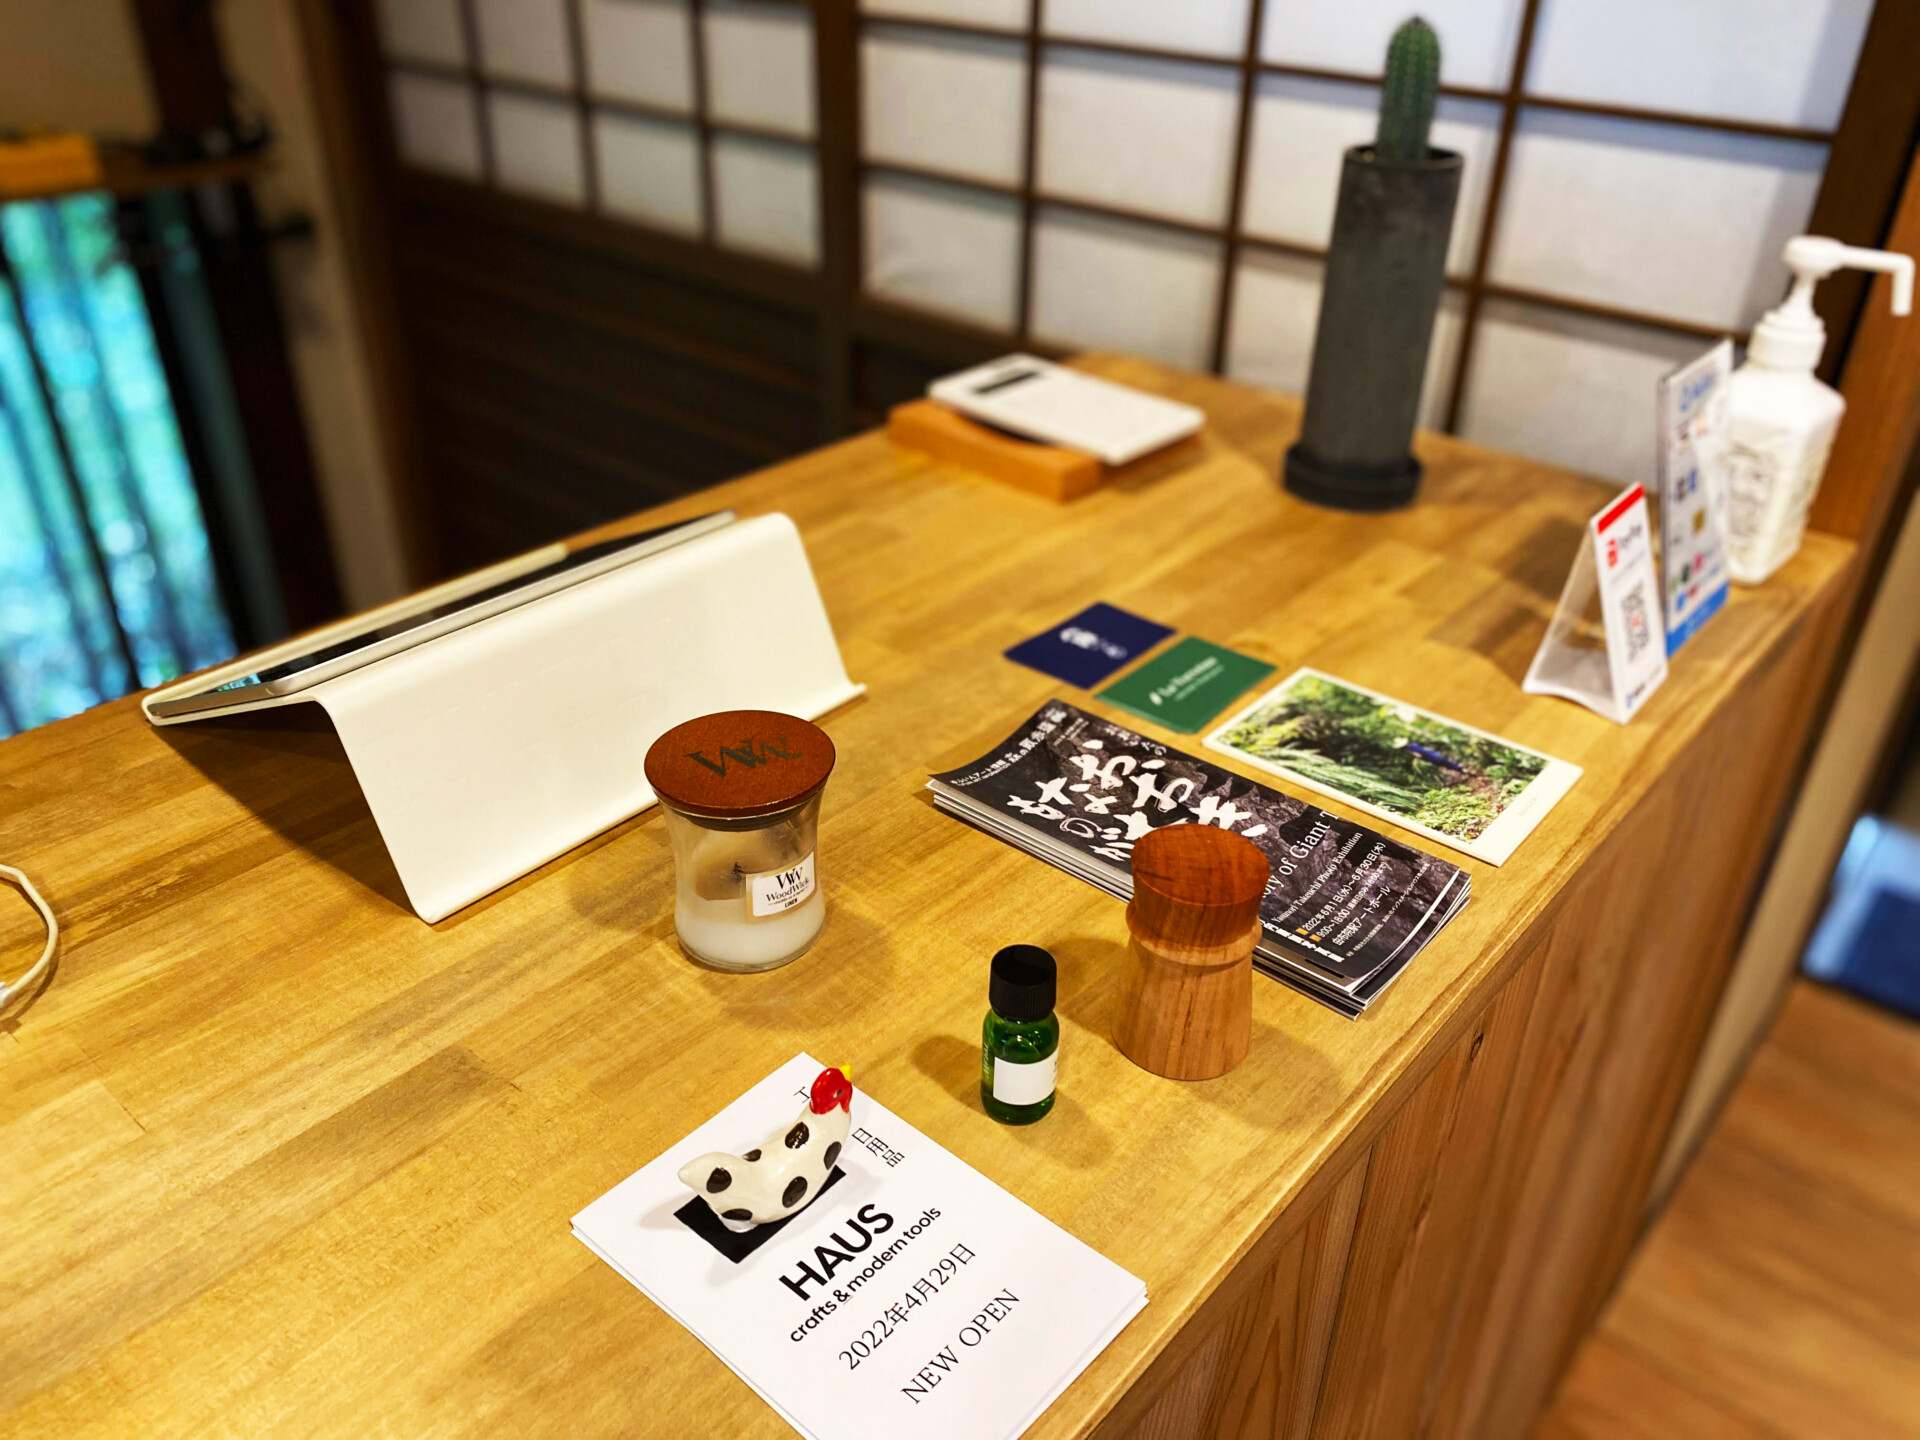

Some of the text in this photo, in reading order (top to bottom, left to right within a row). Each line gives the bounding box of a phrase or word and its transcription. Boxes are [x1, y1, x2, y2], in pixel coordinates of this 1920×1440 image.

[1278, 856, 1299, 877] of
[1288, 820, 1332, 860] Giant
[1296, 882, 1321, 911] Takeuchi
[1316, 864, 1338, 887] Photo
[1332, 832, 1364, 867] Exhibition
[766, 876, 809, 902] WoodWick
[851, 1127, 906, 1168] 日用品
[778, 1203, 895, 1302] HAUS
[790, 1207, 942, 1342] crafts & modern tools
[838, 1243, 976, 1371] 2022年4月29日
[899, 1287, 1021, 1405] NEW OPEN
